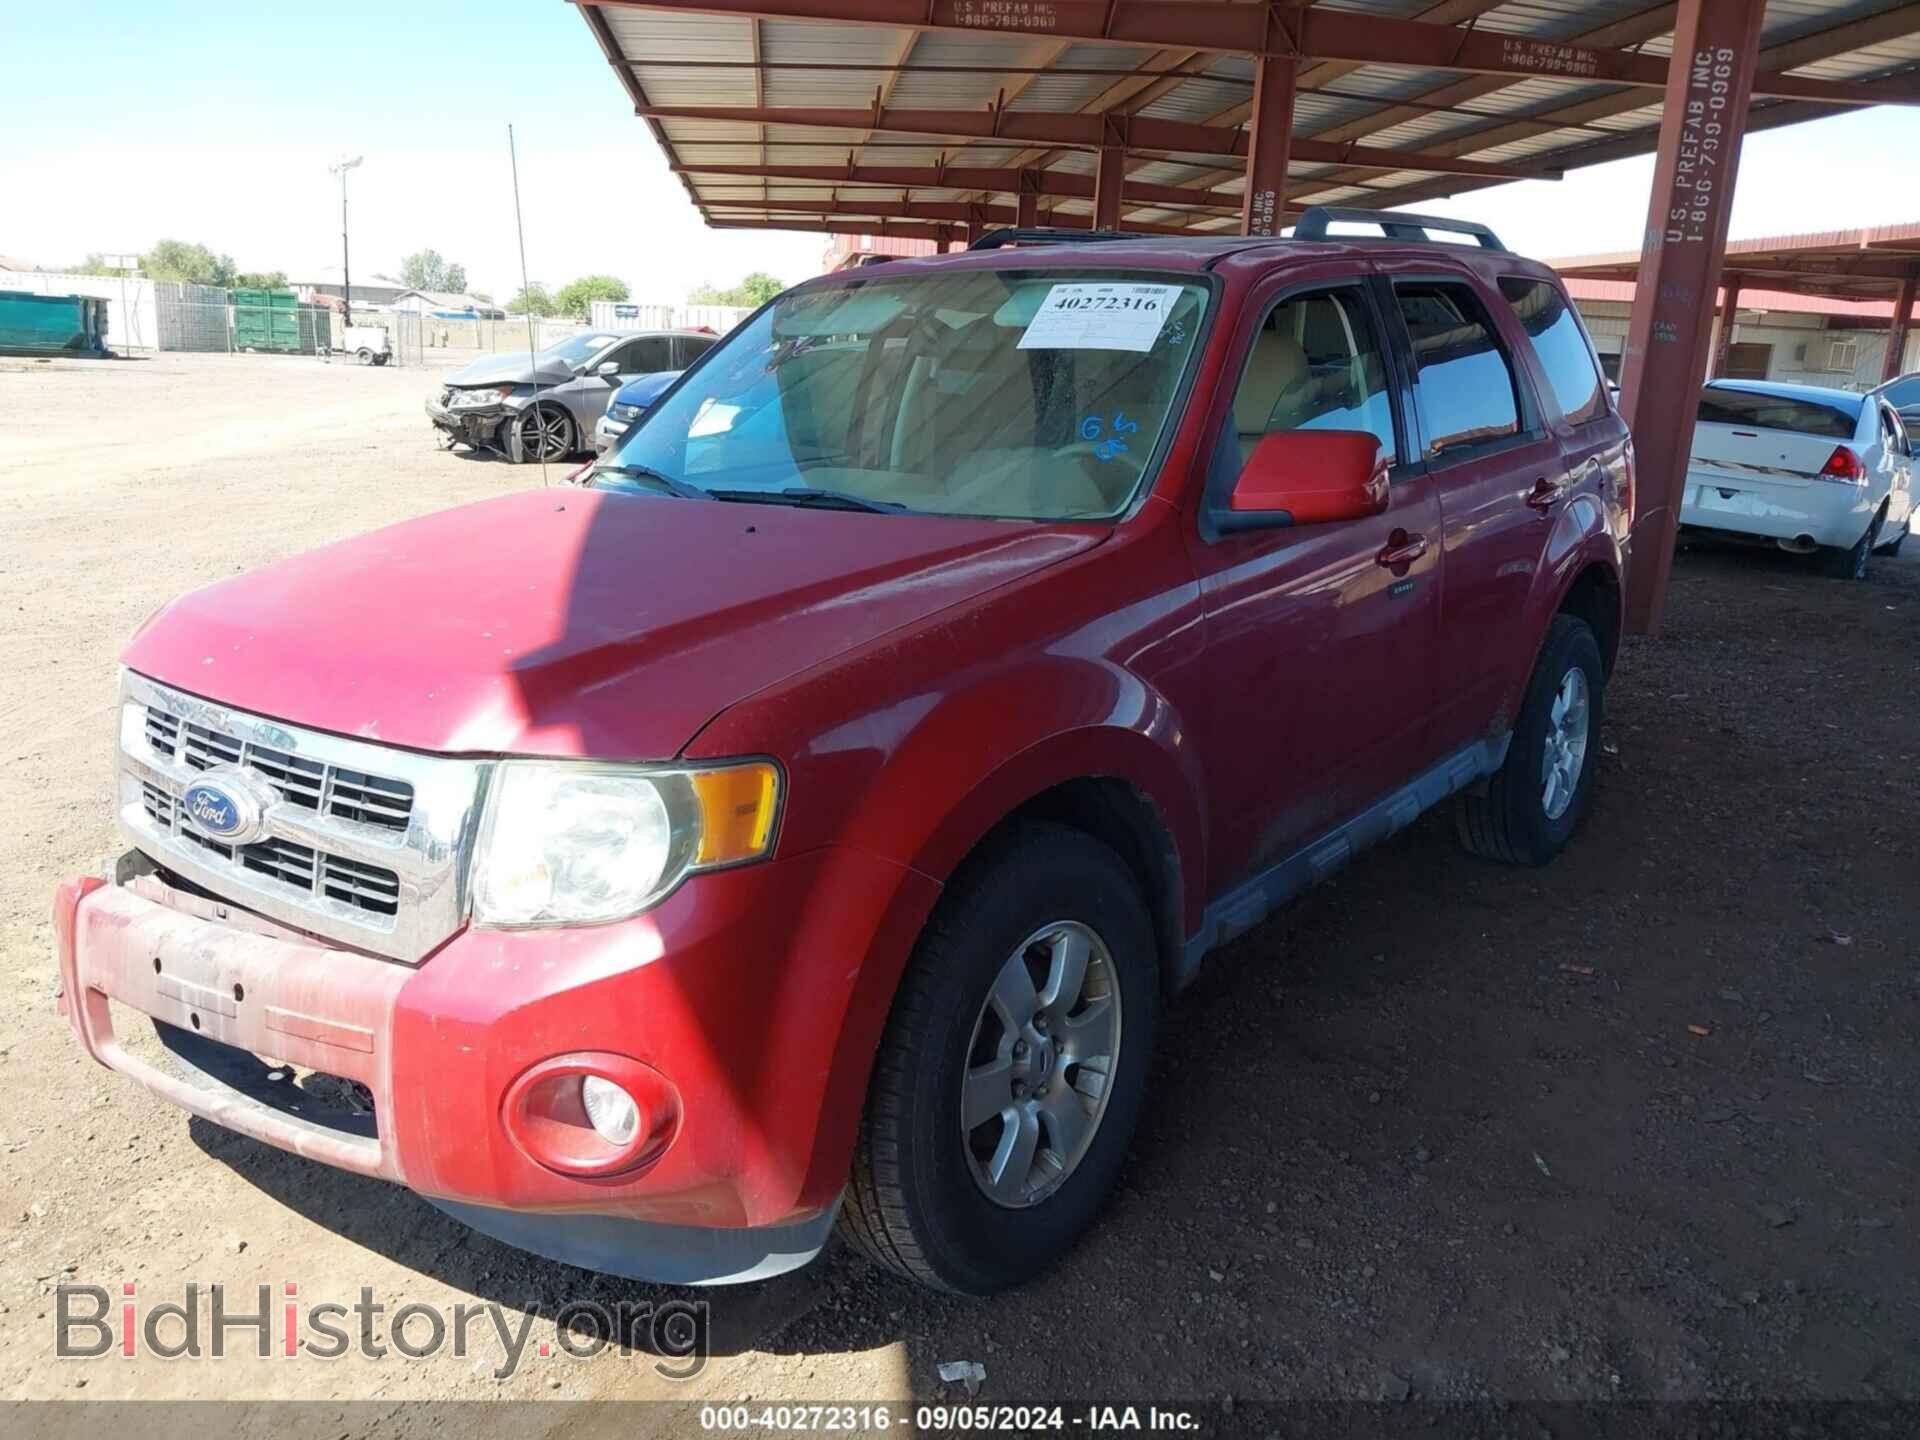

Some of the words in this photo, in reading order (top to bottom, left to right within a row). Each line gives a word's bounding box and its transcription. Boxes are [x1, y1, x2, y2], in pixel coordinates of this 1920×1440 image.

[983, 2, 1029, 14] PREFAB
[1692, 45, 1712, 88] INC.
[1675, 101, 1705, 188] PREFAB
[1686, 48, 1734, 241] 1-866-799-0969
[1665, 201, 1688, 242] U.S.
[1055, 297, 1157, 311] 40272316
[192, 791, 227, 826] Ford
